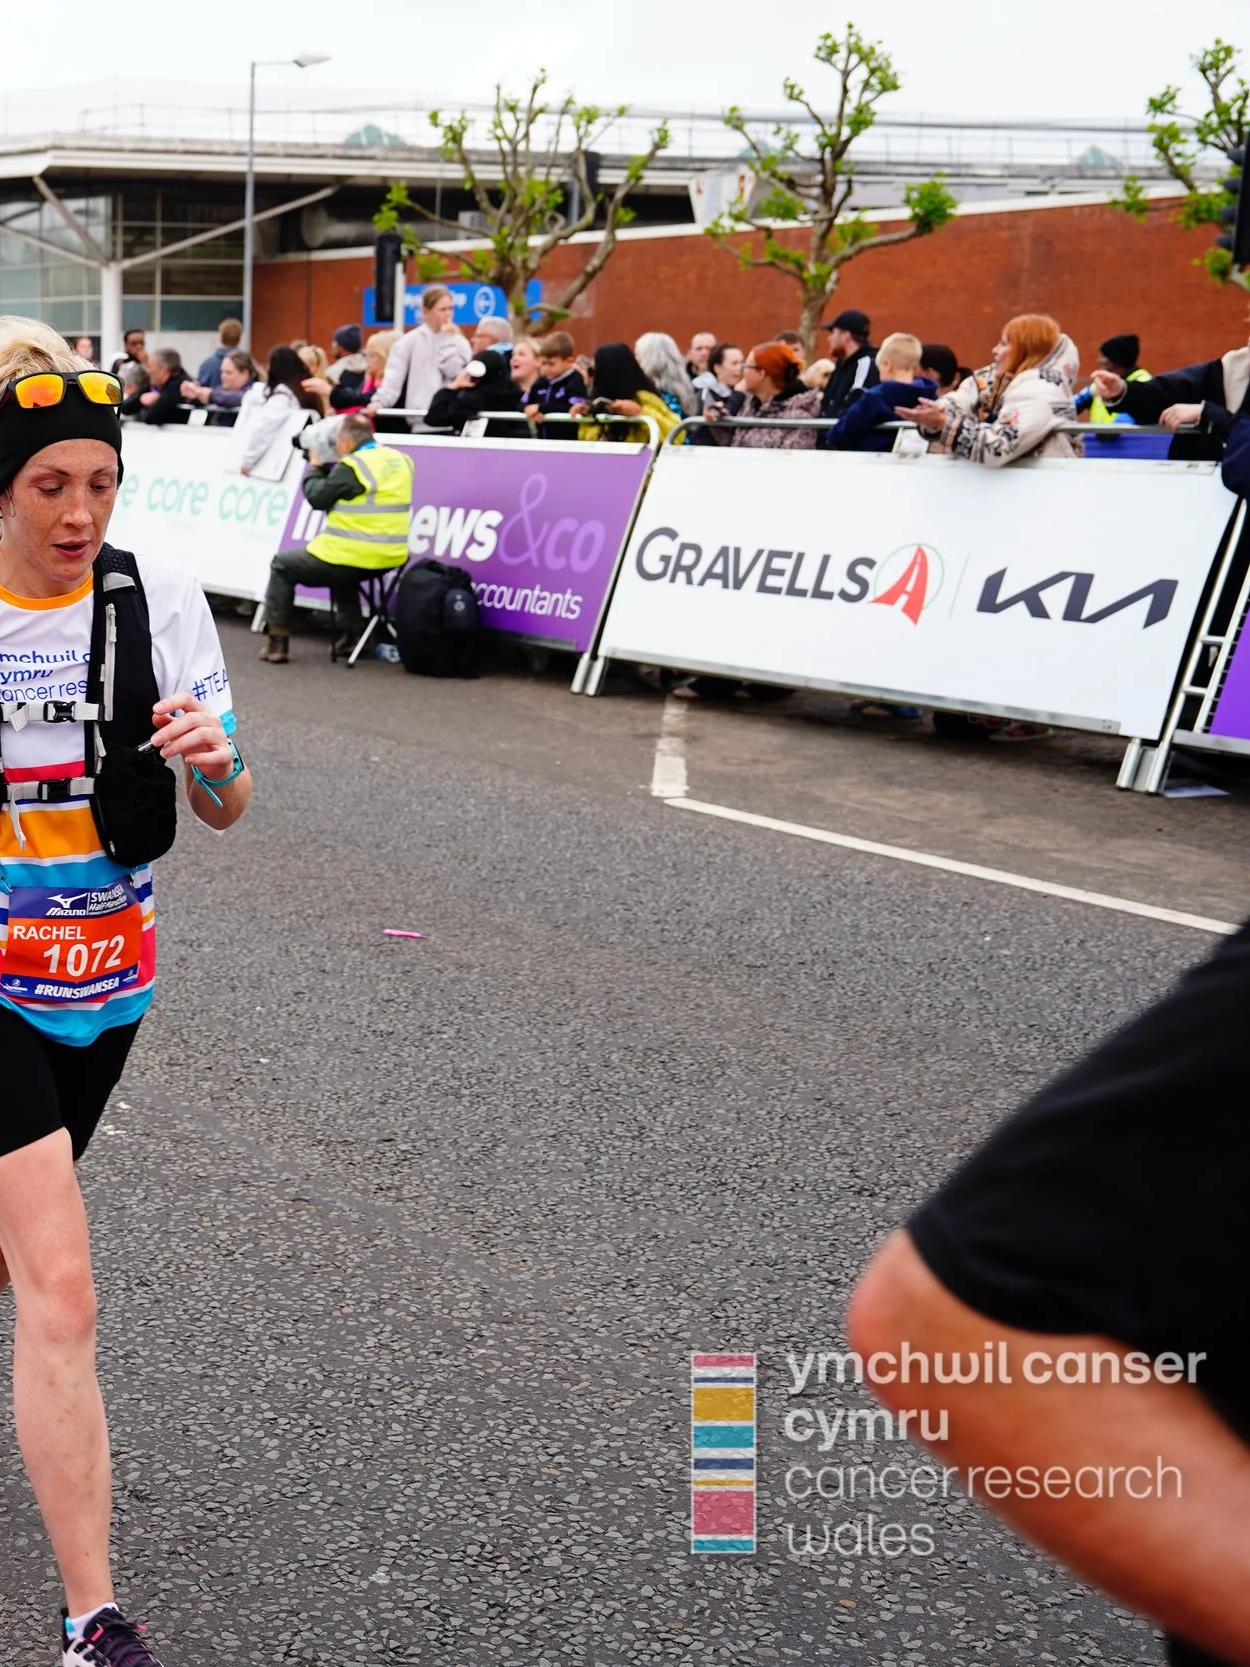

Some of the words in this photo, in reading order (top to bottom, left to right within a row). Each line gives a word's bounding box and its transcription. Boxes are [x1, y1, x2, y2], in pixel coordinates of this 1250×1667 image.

[147, 476, 209, 516] core
[219, 484, 290, 526] core
[635, 526, 878, 603] GRAVELLS
[470, 581, 583, 620] ccountants
[13, 925, 87, 940] RACHEL
[43, 935, 125, 977] 1072
[34, 977, 120, 999] #RUNSWANSEA
